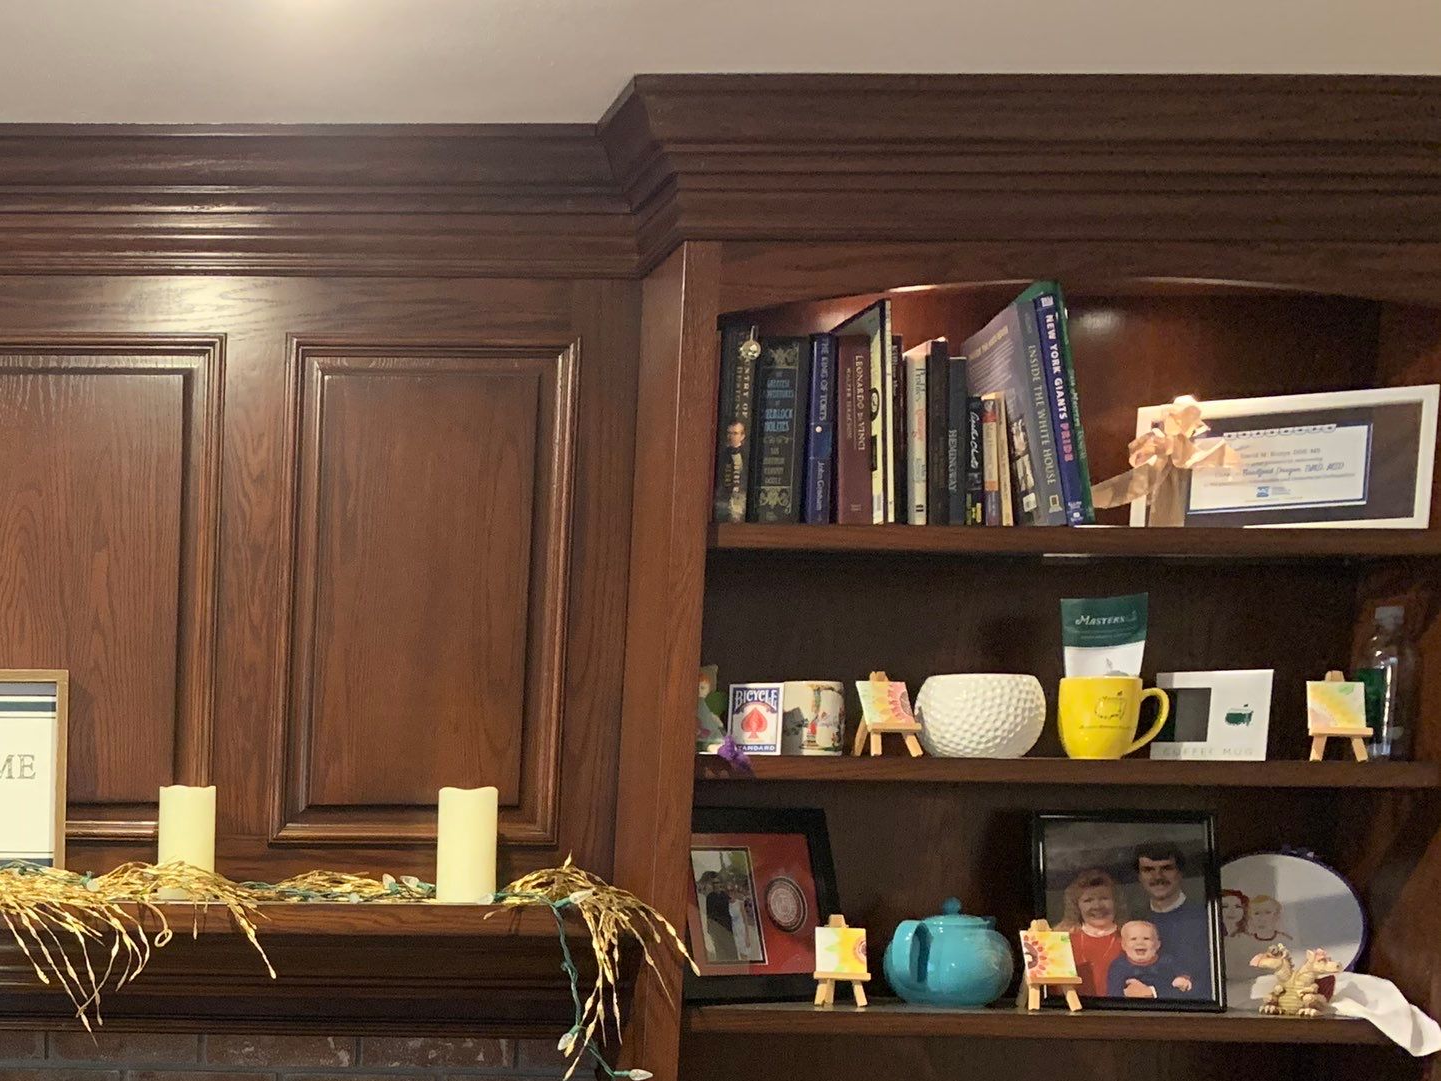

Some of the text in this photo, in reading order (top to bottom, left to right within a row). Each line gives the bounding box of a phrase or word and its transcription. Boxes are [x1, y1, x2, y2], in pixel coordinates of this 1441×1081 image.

[855, 355, 865, 410] LEONARDO
[1028, 345, 1057, 485] INSIDE THE WHITE HOUSE
[1045, 314, 1074, 462] NEW YORK GIANTS PRIDE
[734, 690, 778, 711] BICYCLE
